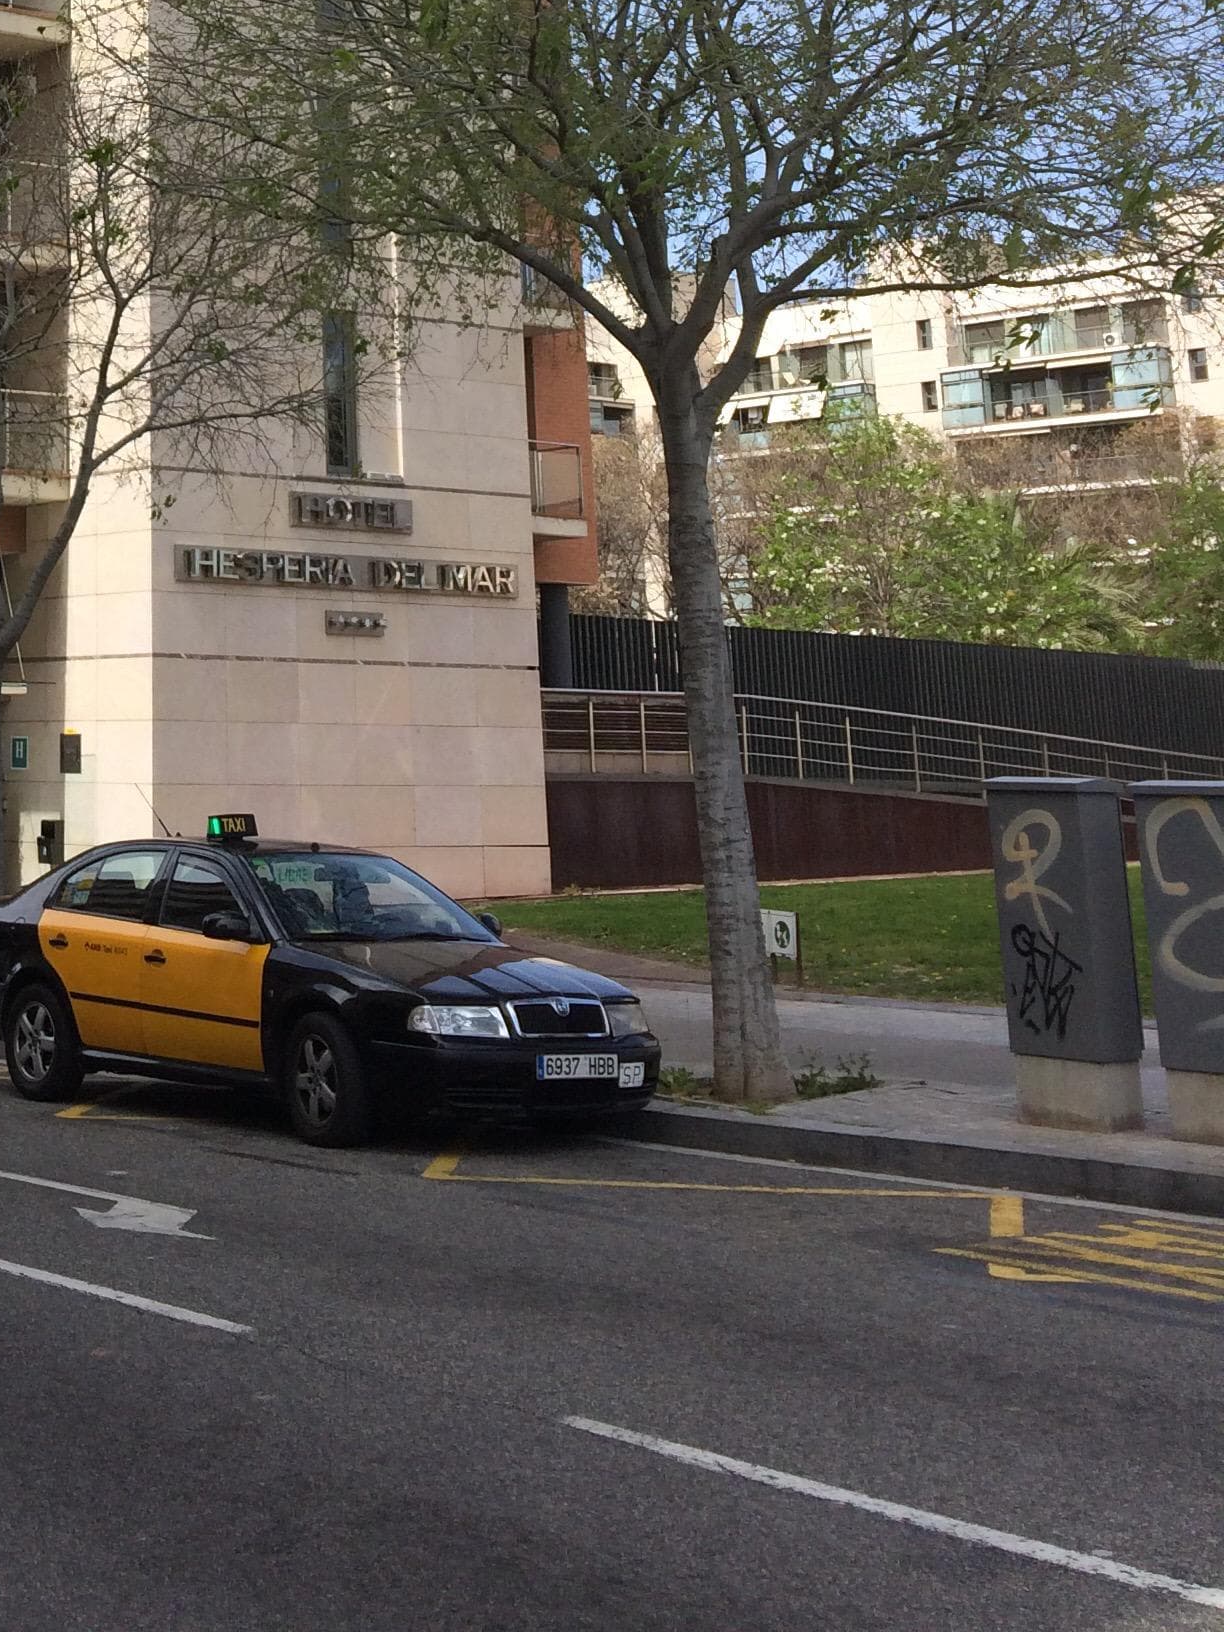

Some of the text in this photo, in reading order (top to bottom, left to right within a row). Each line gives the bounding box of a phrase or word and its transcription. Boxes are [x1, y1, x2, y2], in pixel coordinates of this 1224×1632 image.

[296, 494, 412, 529] HOTEL
[185, 548, 515, 594] HESPERIA DEL MAR
[221, 816, 246, 833] TAXI
[546, 1057, 615, 1076] 6937 HBB
[623, 1065, 641, 1085] SP
